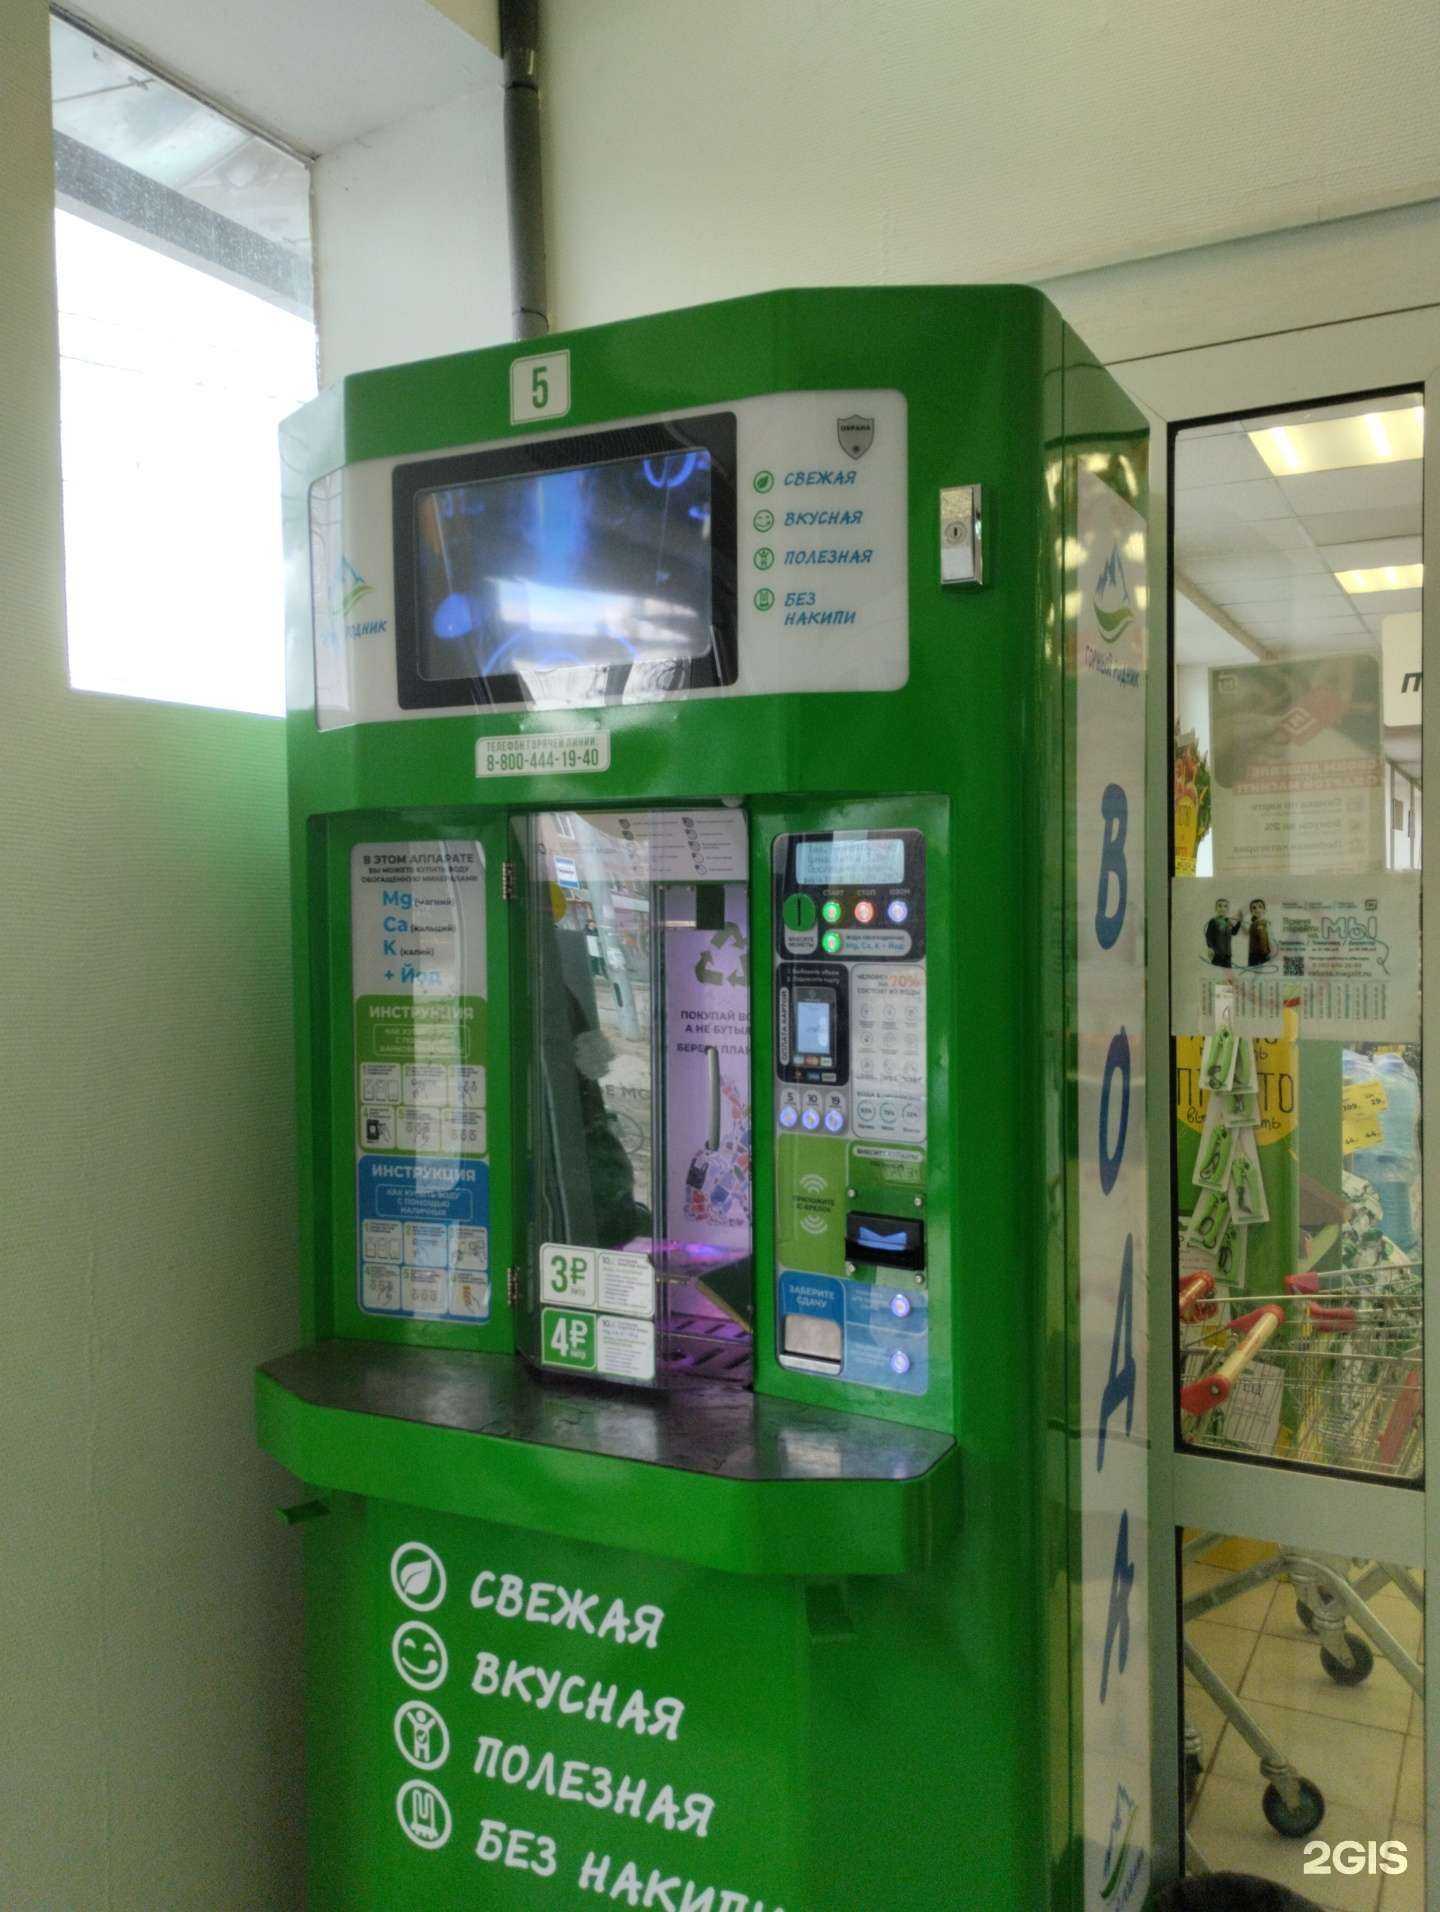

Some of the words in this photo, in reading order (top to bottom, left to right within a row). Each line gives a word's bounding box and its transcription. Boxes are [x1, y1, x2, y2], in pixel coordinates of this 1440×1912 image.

[532, 366, 549, 409] 5
[784, 471, 857, 486] СВЕЖАЯ
[784, 510, 863, 526] ВКУСНАЯ
[784, 549, 873, 565] ПОЛЕЗНАЯ
[784, 592, 816, 608] БЕЗ
[784, 610, 857, 626] НАКИПИ
[487, 741, 525, 752] ТЕЛЕФОН
[487, 748, 599, 772] 8-800-444-19-40
[364, 855, 371, 864] В
[374, 855, 406, 864] ЭТОМ
[409, 853, 474, 864] АППАРАТЕ
[383, 890, 412, 910] Mg
[384, 916, 408, 932] Ca
[680, 1010, 735, 1021] ПОКУПАЙ
[685, 1024, 693, 1033] А
[695, 1024, 711, 1034] НЕ
[787, 1092, 794, 1102] 5
[372, 1164, 476, 1182] ИНСТРУКЦИЯ
[469, 1570, 665, 1649] СВЕЖАЯ
[471, 1651, 686, 1741] ВКУСНАЯ
[473, 1735, 716, 1838] ПОЛЕЗНАЯ
[475, 1818, 557, 1878] БЕЗ
